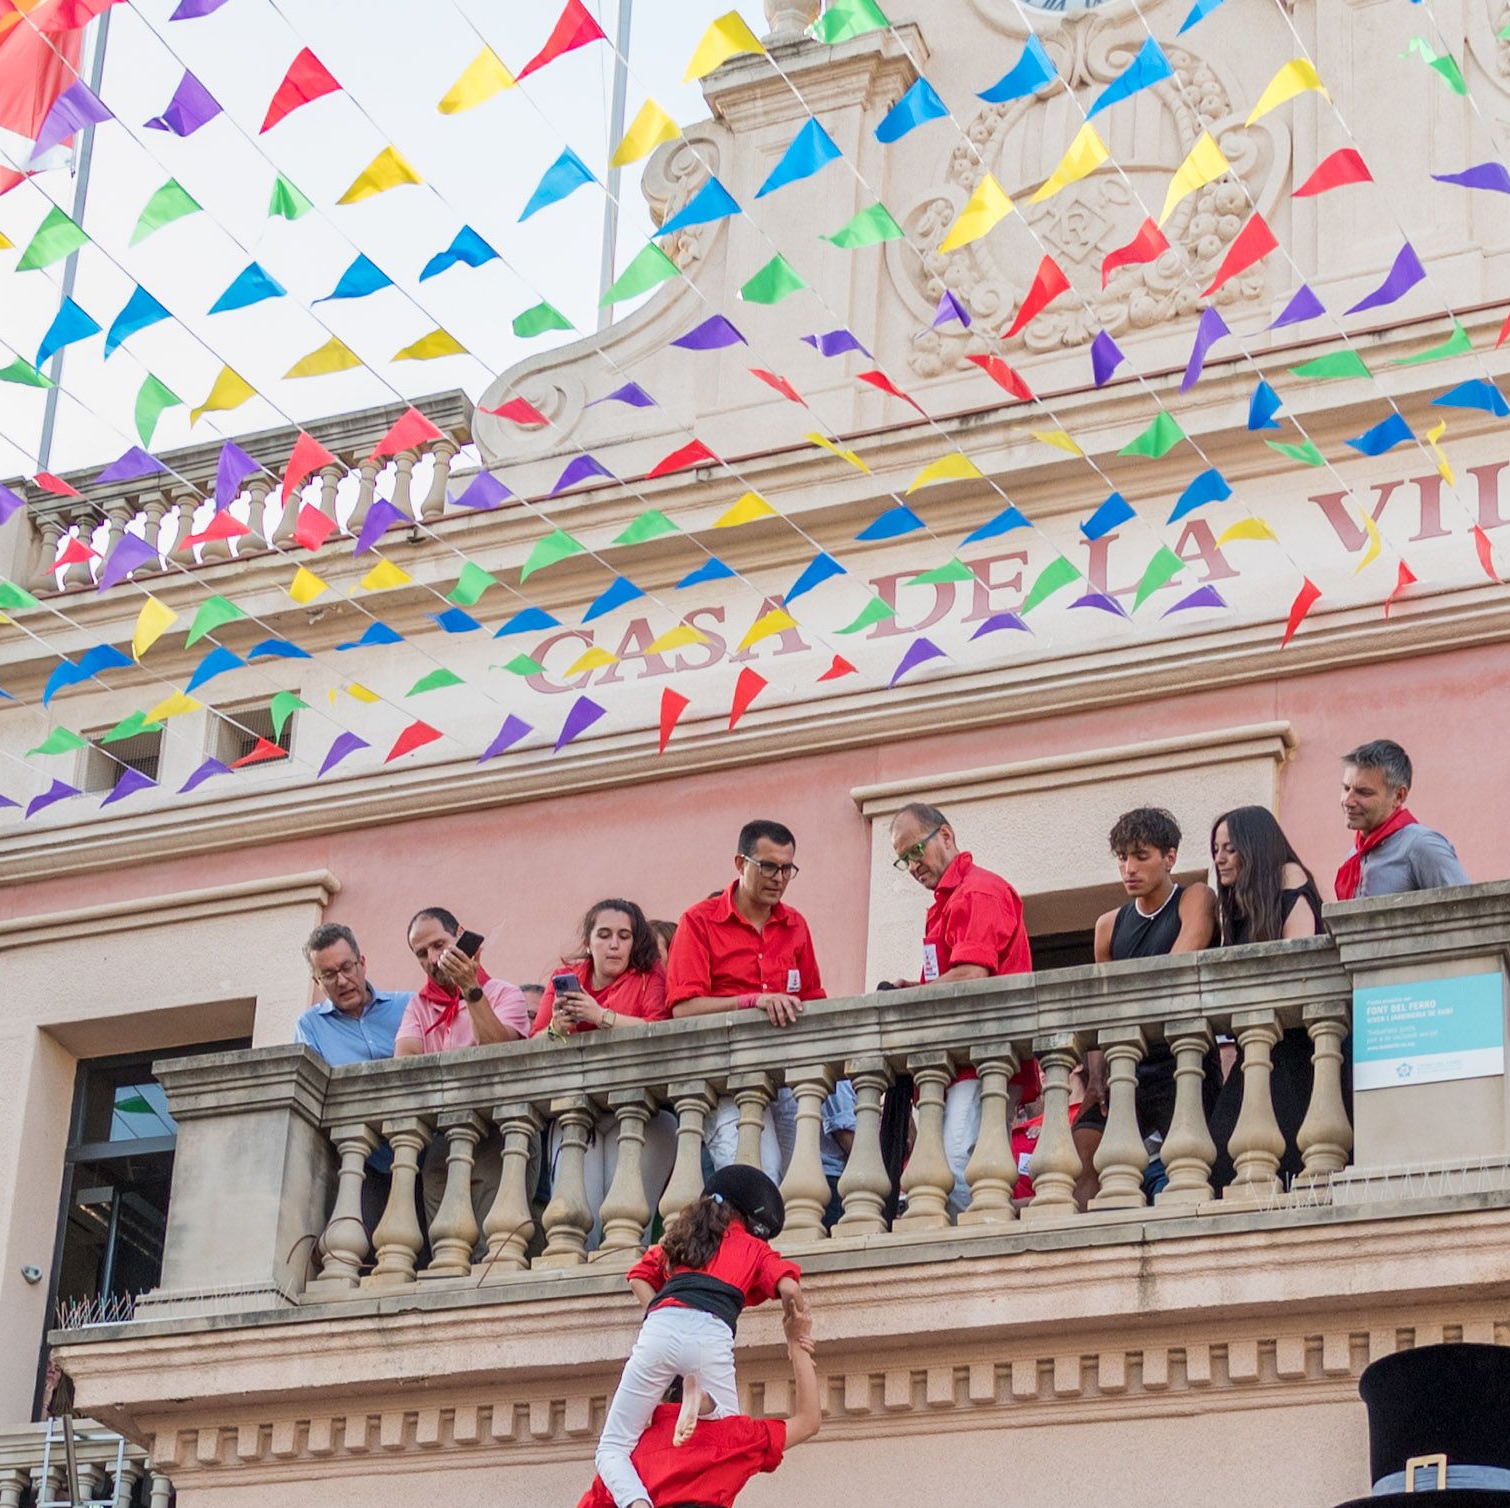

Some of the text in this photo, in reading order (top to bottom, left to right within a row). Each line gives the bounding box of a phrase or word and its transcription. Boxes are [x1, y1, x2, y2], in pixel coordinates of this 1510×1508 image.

[525, 594, 812, 694] CASA
[866, 550, 1029, 640] DE
[1079, 518, 1240, 597] LA
[1367, 1005, 1388, 1016] FONT
[1392, 1003, 1408, 1013] DEL
[1409, 1000, 1436, 1010] FERRO
